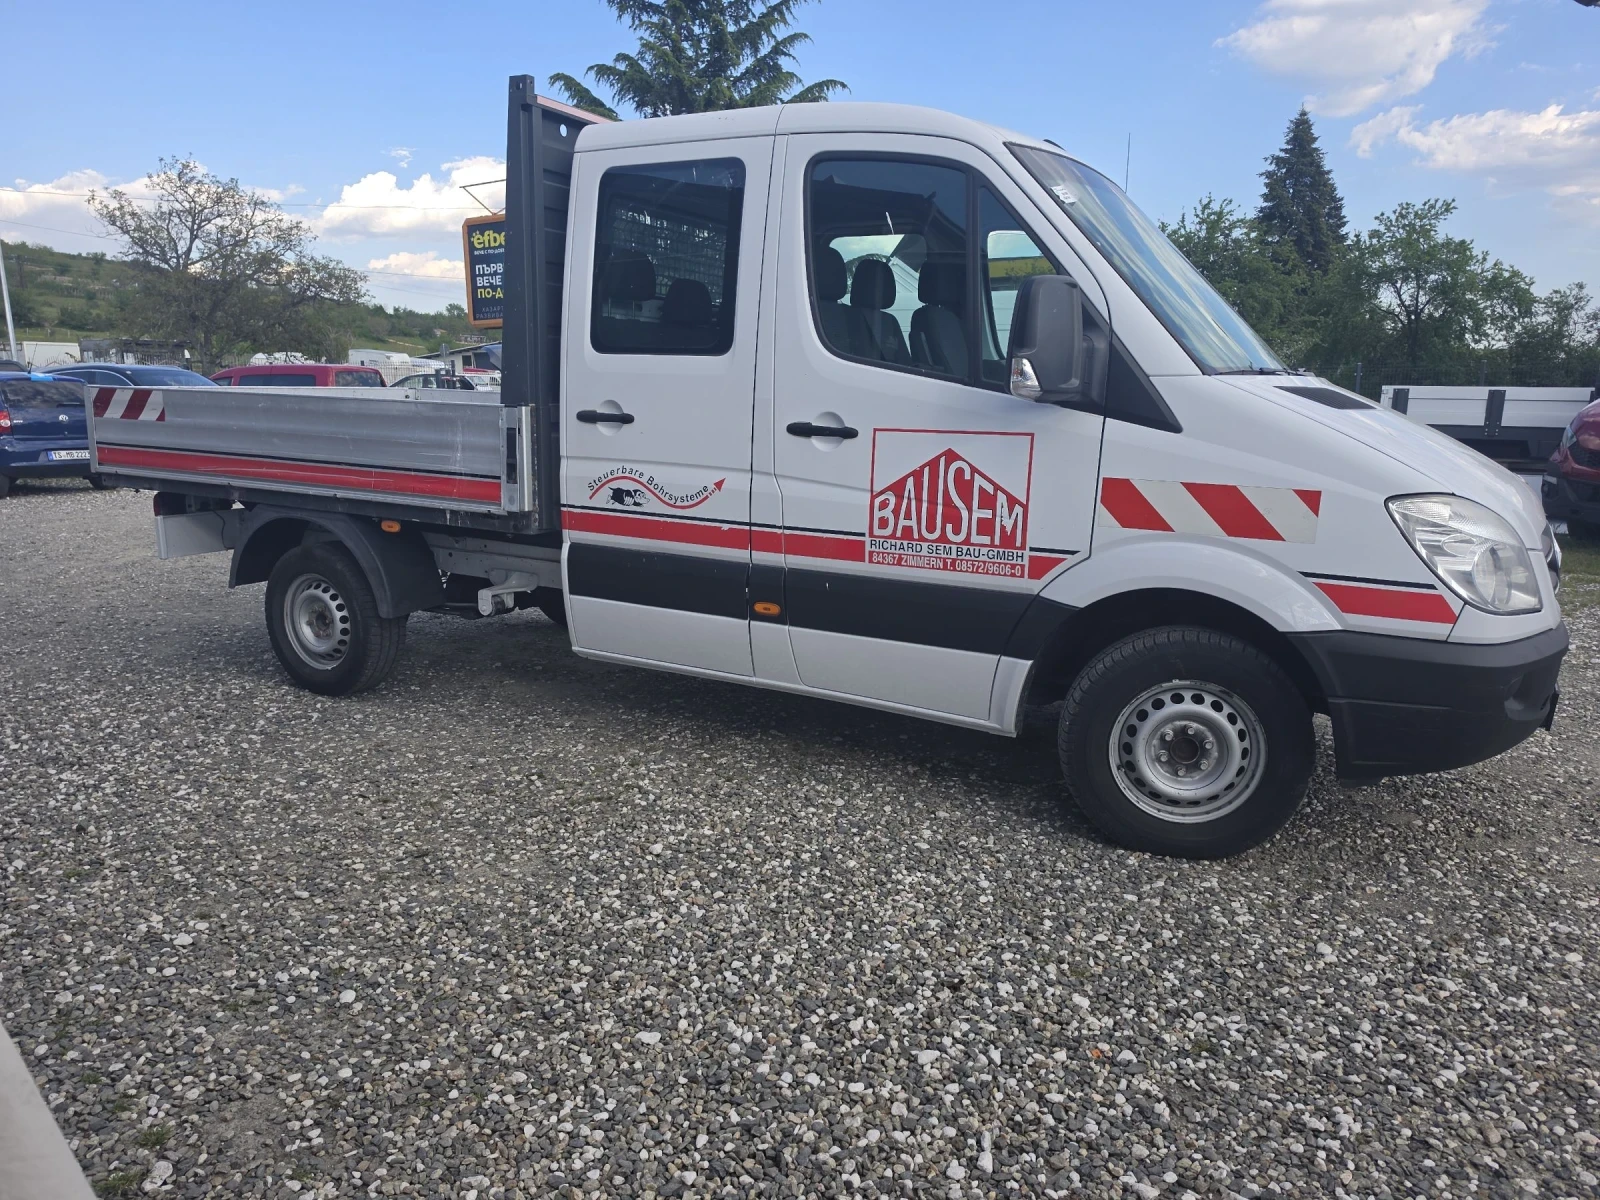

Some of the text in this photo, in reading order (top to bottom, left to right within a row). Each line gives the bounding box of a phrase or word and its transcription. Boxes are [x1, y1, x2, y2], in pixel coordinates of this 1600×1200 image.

[475, 263, 504, 274] ПЪРВ
[476, 275, 502, 286] ВЕЧЕ
[477, 287, 504, 299] ПО-Д
[588, 465, 709, 505] Steuerbare Bohrsysteme
[873, 455, 1024, 547] BAUSEM
[870, 539, 1024, 562] RICHARD SEM BAU-GMBH
[872, 552, 1021, 576] 84367 ZIMMERN T. 08572/9606-0
